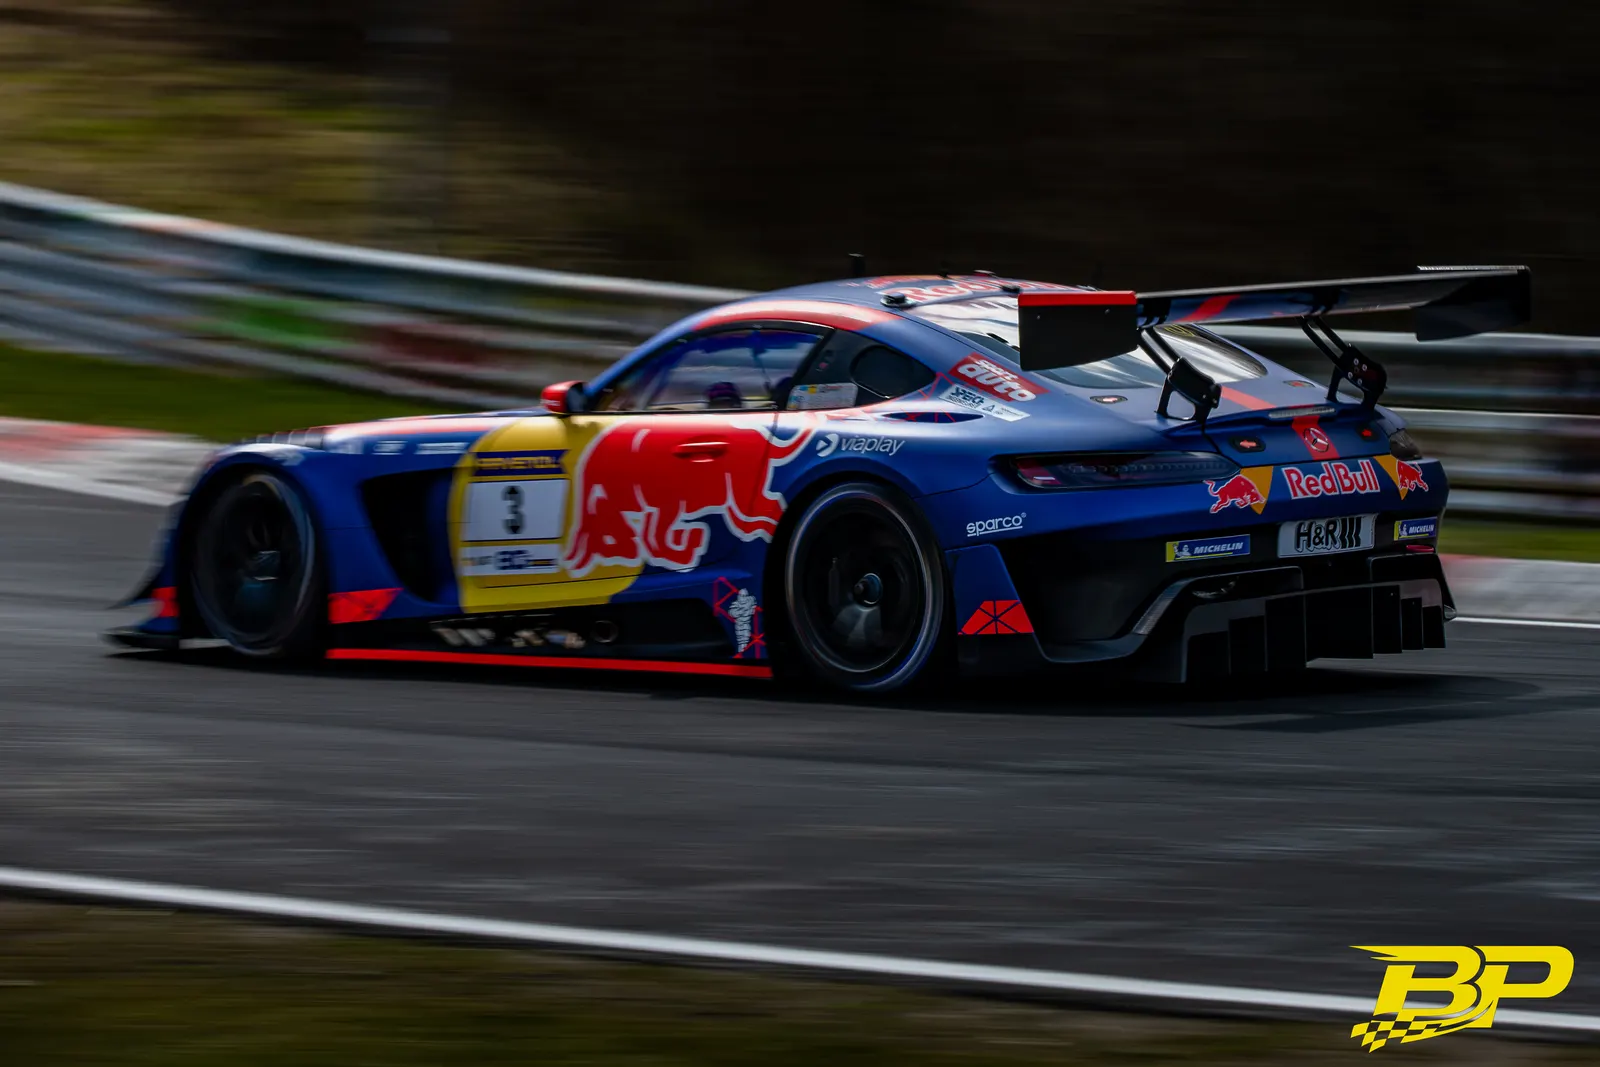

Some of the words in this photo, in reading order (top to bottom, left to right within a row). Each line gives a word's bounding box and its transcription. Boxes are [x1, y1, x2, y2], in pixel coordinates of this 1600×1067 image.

[957, 363, 1037, 402] auto
[841, 435, 906, 457] viaplay
[501, 485, 525, 535] 3
[1409, 524, 1435, 536] MICHELIN
[1193, 541, 1244, 556] MICHELIN
